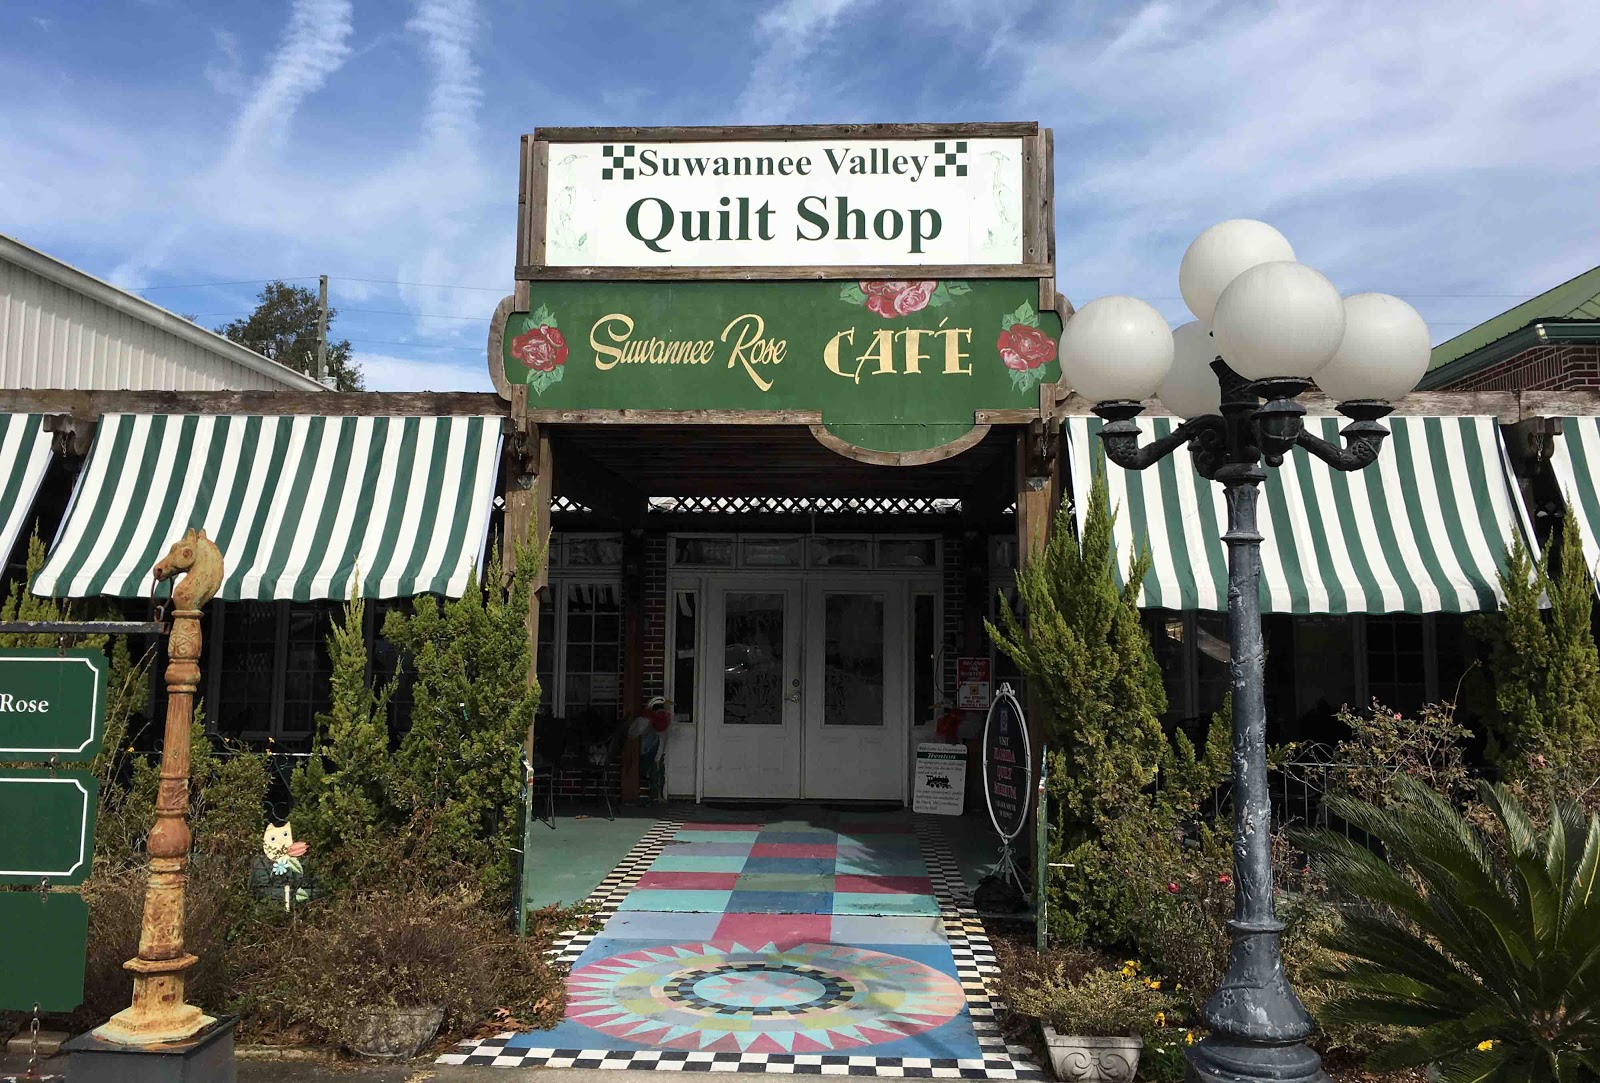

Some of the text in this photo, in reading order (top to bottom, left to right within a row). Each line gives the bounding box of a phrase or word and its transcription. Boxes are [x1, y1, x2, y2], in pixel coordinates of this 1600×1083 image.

[639, 149, 929, 182] Suwannee Valley
[625, 195, 942, 253] Quilt Shop
[589, 313, 973, 392] Suwannee Rose CAFÉ
[0, 693, 49, 713] Rose
[927, 752, 957, 760] Trenton
